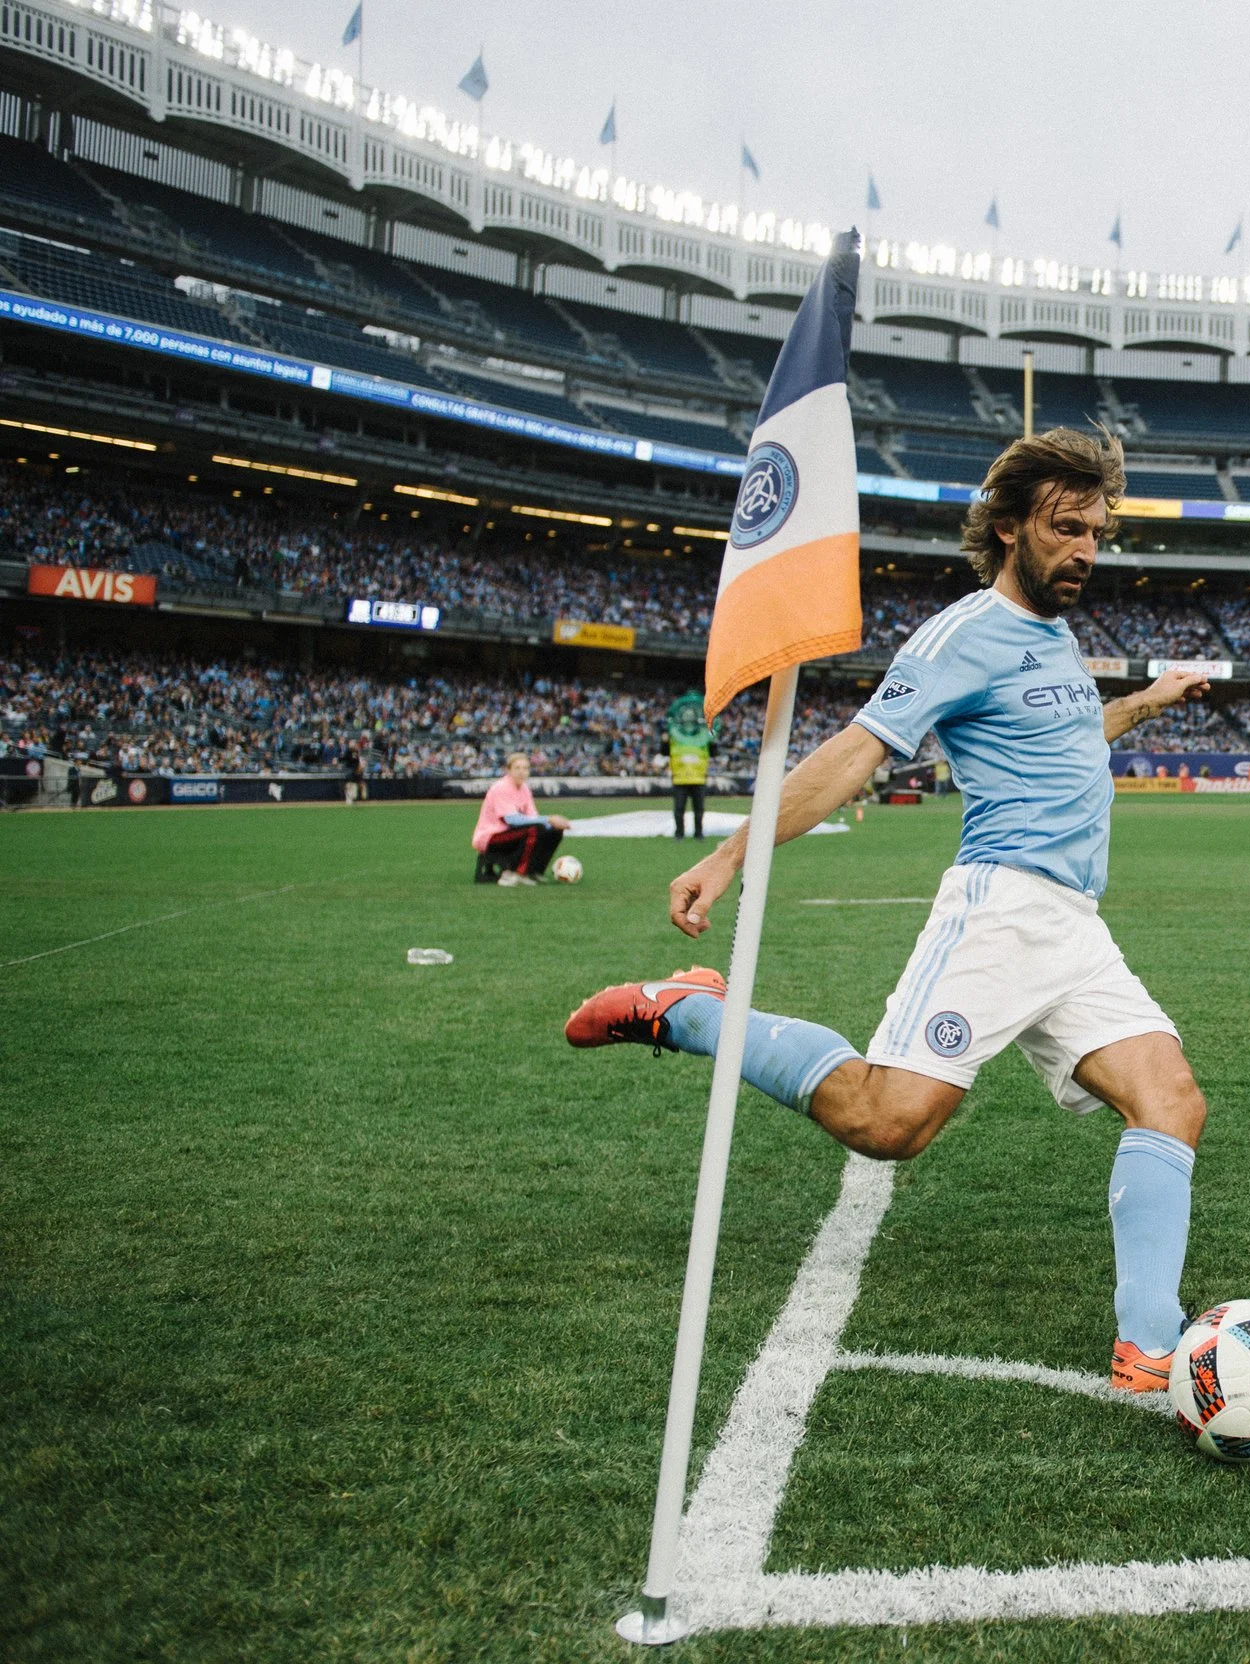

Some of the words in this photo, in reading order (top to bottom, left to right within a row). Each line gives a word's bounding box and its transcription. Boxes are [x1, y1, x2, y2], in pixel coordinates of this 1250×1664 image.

[12, 304, 67, 325] ayudado
[107, 323, 123, 337] de
[54, 568, 135, 603] AVIS
[1019, 662, 1042, 673] adidas
[889, 682, 908, 694] MLS
[172, 781, 218, 798] GEICO
